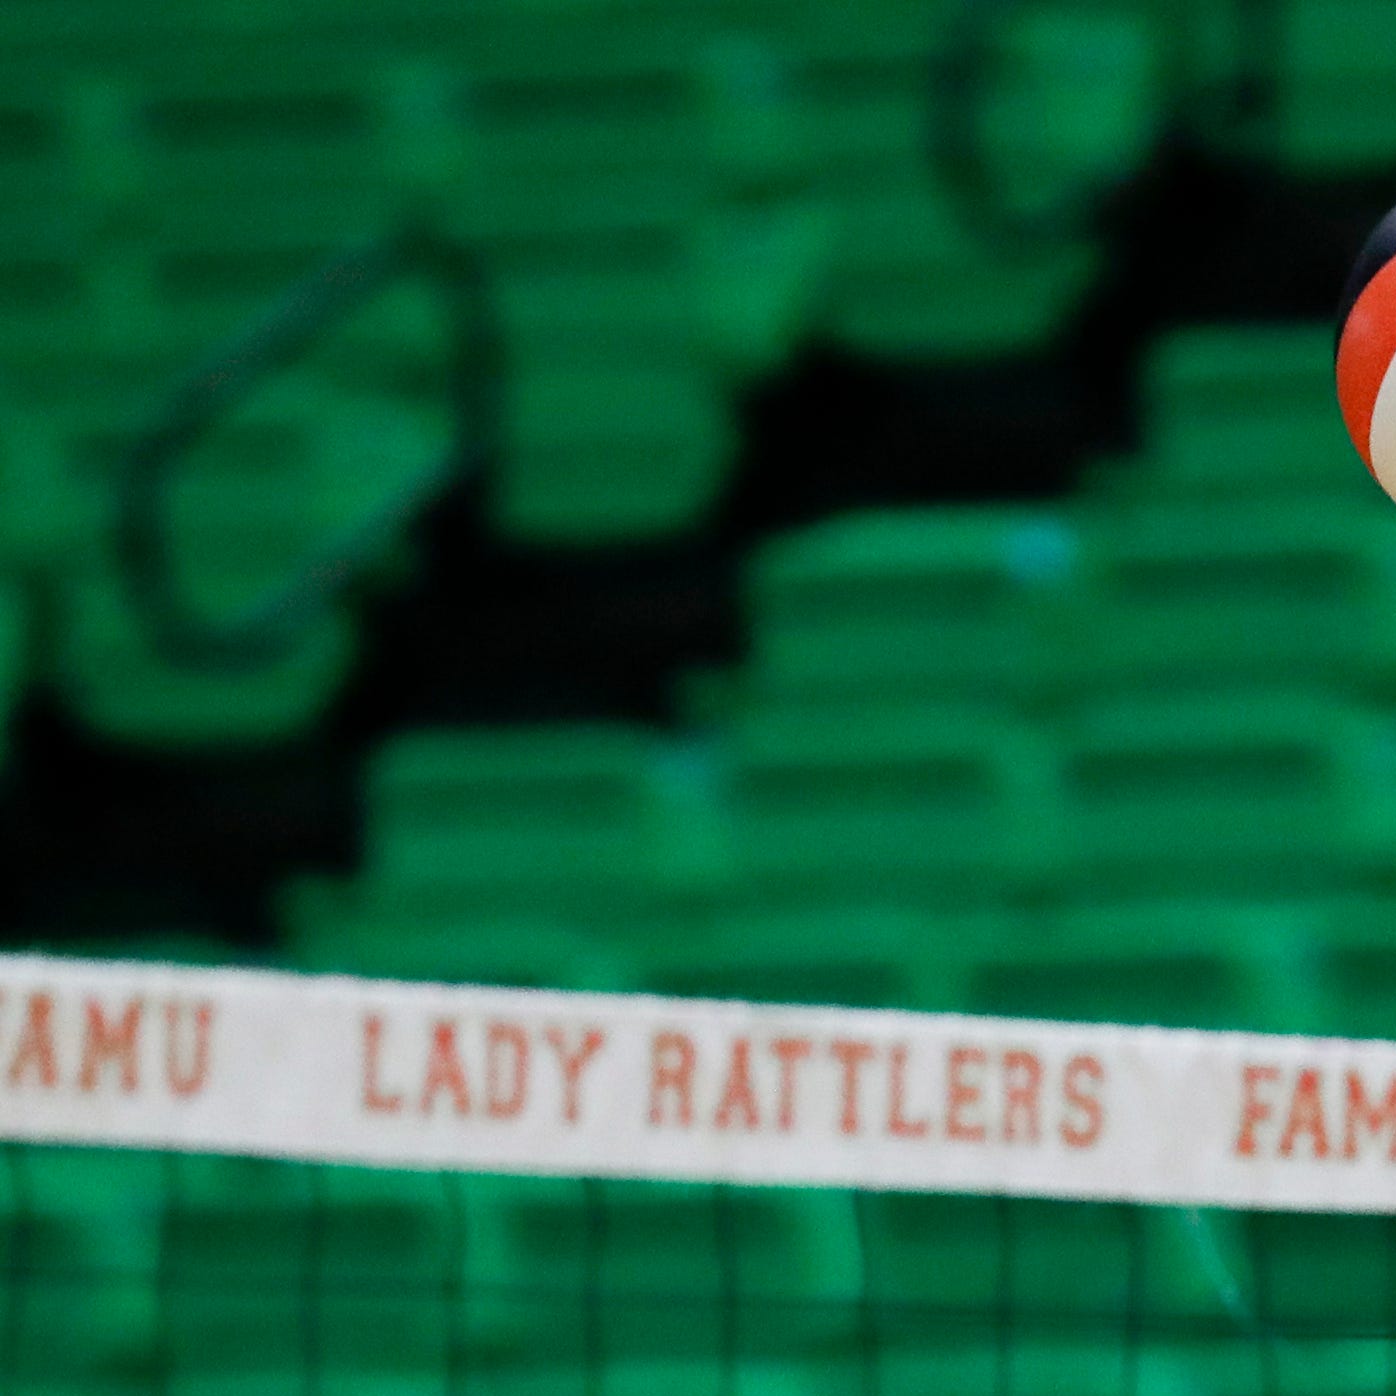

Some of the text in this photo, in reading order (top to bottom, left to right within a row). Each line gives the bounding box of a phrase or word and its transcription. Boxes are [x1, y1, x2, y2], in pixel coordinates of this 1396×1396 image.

[0, 992, 213, 1100] AMU
[362, 1014, 606, 1126] LADY
[646, 1029, 1107, 1151] RATTLERS
